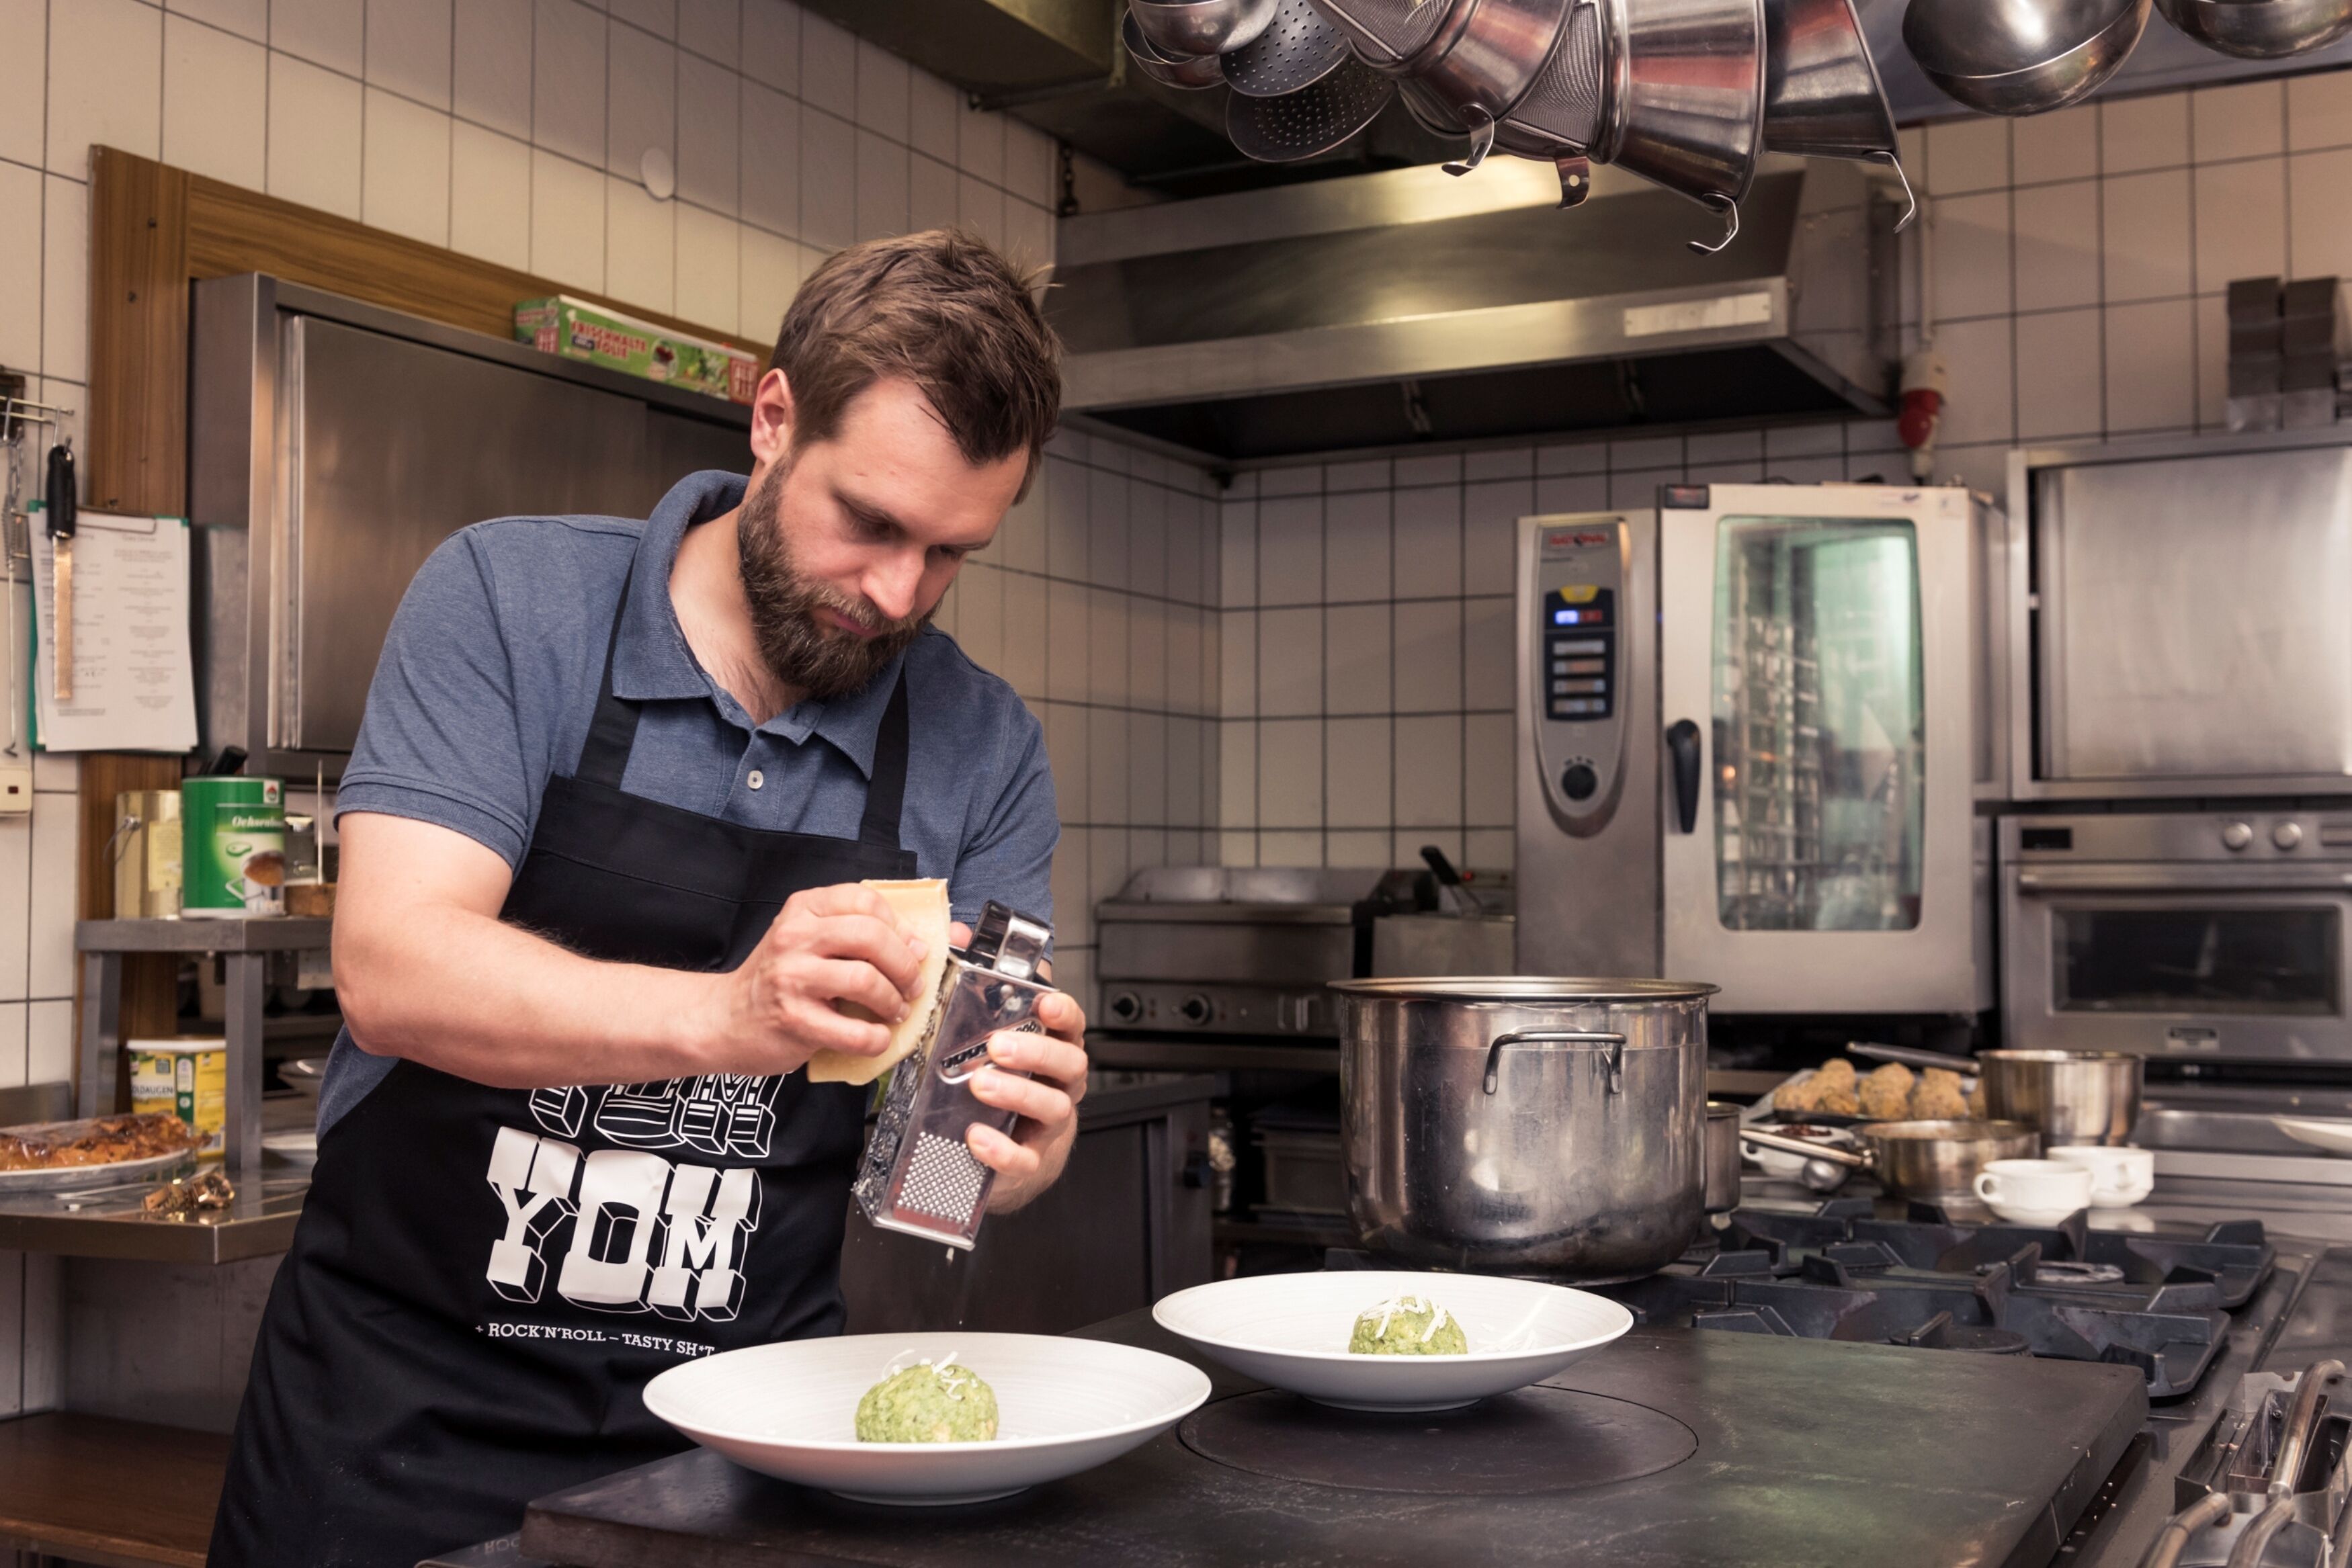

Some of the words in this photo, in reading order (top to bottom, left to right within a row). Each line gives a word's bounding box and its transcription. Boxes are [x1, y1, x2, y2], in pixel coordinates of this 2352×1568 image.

[487, 1126, 762, 1321] YOM
[488, 1323, 606, 1342] ROCK'N'ROLL
[622, 1333, 673, 1351] TASTY
